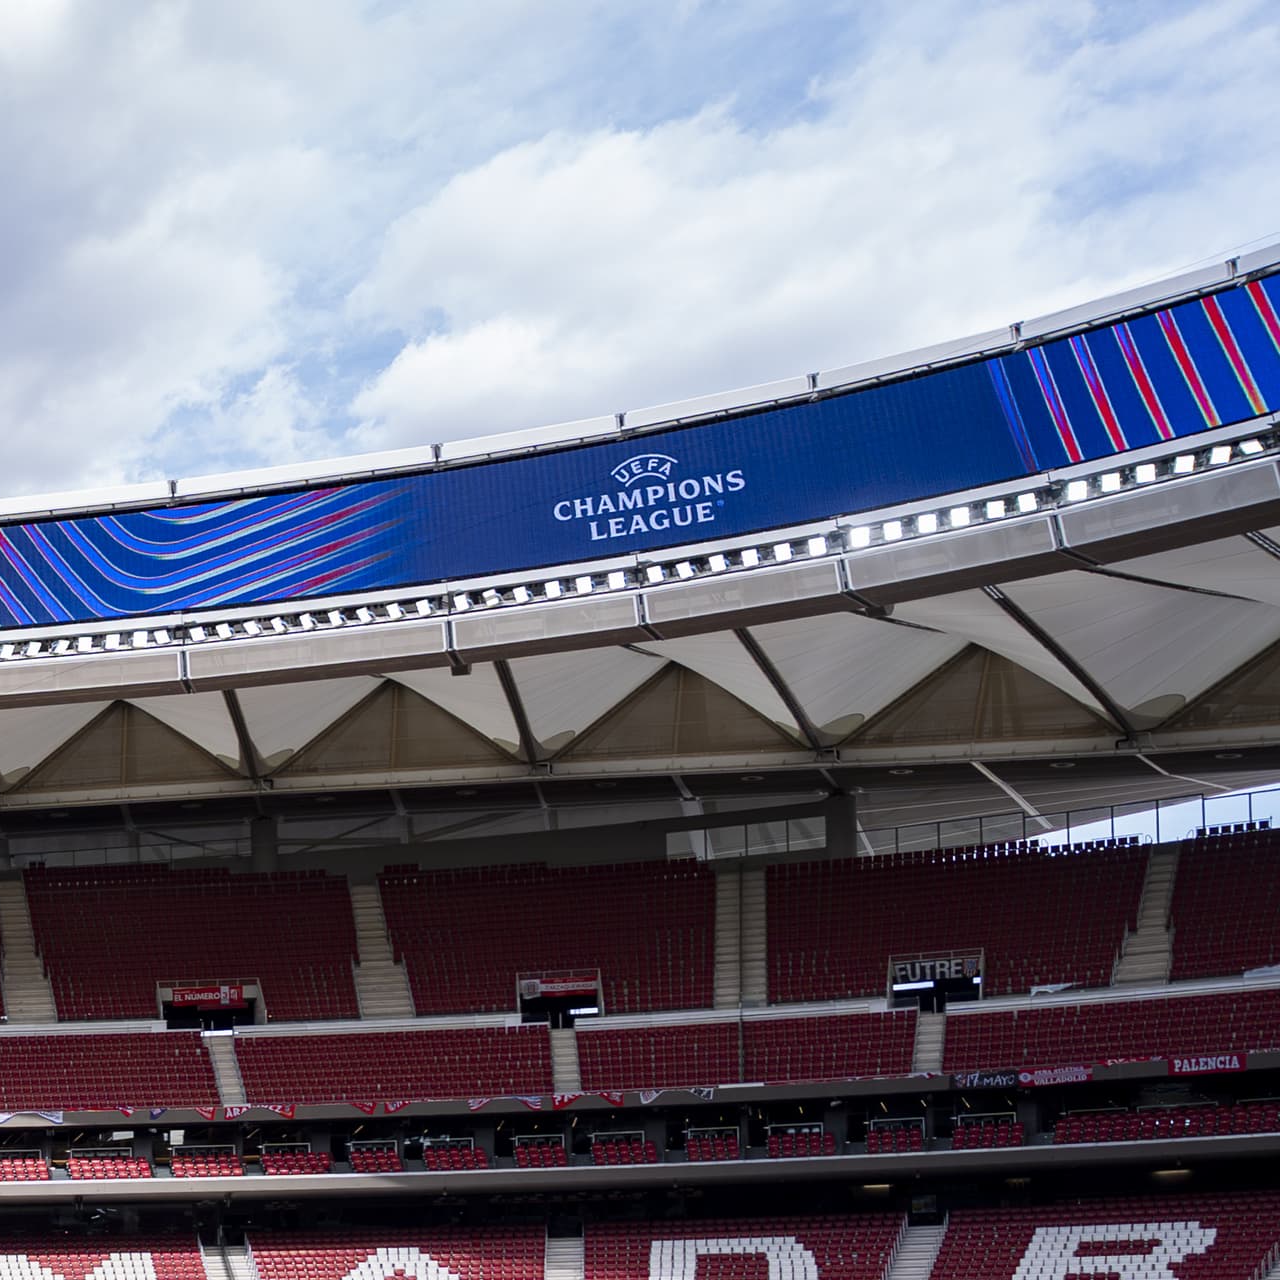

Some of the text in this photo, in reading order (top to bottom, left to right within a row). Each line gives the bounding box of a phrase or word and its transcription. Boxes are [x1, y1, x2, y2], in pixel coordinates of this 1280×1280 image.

[615, 458, 671, 483] UEFA
[553, 469, 746, 521] CHAMPIONS
[589, 502, 715, 541] LEAGUE
[895, 959, 964, 984] FUTRE
[174, 994, 183, 1002] EL
[1173, 1055, 1240, 1073] PALENCIA
